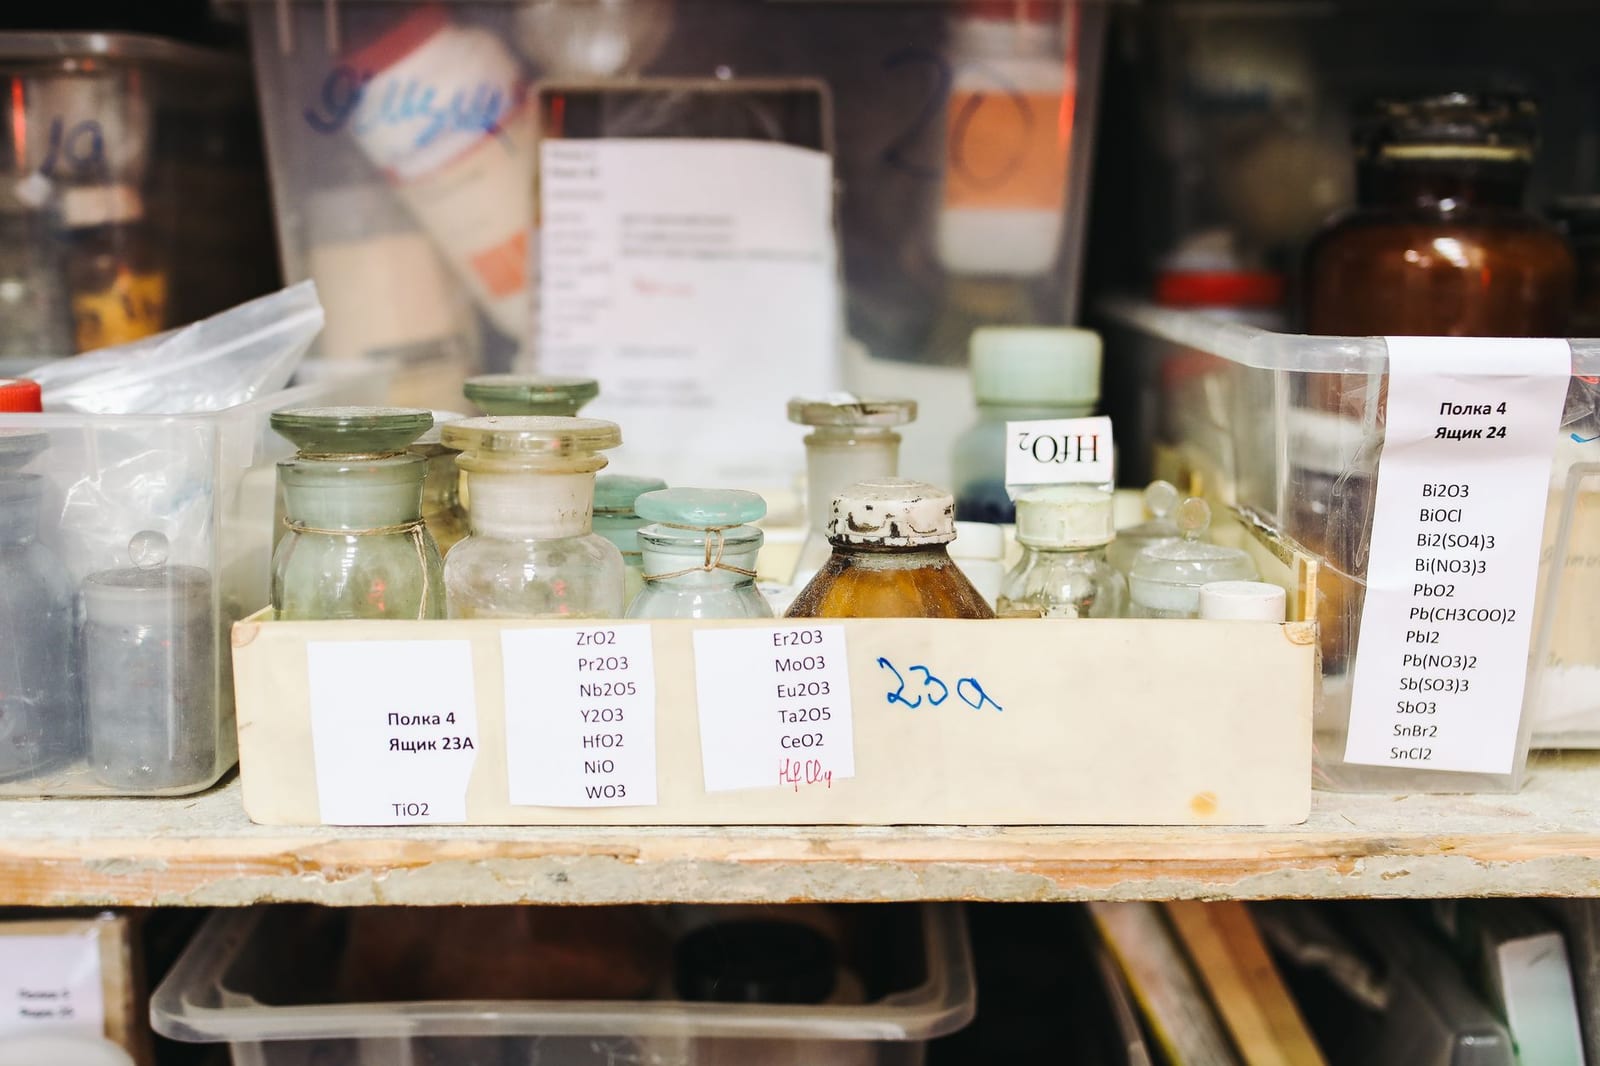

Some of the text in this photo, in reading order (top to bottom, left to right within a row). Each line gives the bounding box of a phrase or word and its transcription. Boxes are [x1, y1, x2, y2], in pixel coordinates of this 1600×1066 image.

[1439, 401, 1507, 416] Полка 4
[1433, 425, 1507, 442] Ящик 24
[1422, 483, 1470, 499] Bi2O3
[1419, 508, 1462, 523] BiOCl
[1416, 532, 1496, 552] Bi2(SO4)3
[1415, 557, 1487, 577] Bi(NO3)3
[1413, 582, 1455, 598] PbO2
[1409, 606, 1516, 625] Pb(CH3COO)2
[576, 630, 616, 646] ZrO2
[773, 629, 823, 647] Er2O3
[1405, 629, 1440, 644] PbI2
[578, 656, 629, 672] Pr2O3
[775, 655, 826, 673] MoO3
[1402, 653, 1478, 672] Pb(NO3)2
[579, 681, 637, 698] Nb2O5
[776, 680, 831, 699] Eu2O3
[1399, 676, 1470, 695] Sb(SO3)3
[580, 707, 624, 724] Y2O3
[777, 706, 832, 724] Ta2O5
[1396, 700, 1437, 715] SbO3
[387, 711, 456, 726] Полка 4
[1392, 723, 1438, 738] SnBr2
[389, 736, 475, 754] Ящик 23A
[582, 733, 625, 749] HfO2
[780, 732, 825, 749] CeO2
[1389, 746, 1432, 761] SnCl2
[584, 759, 615, 775] NiO
[585, 783, 627, 800] WO3
[391, 802, 430, 817] TiO2
